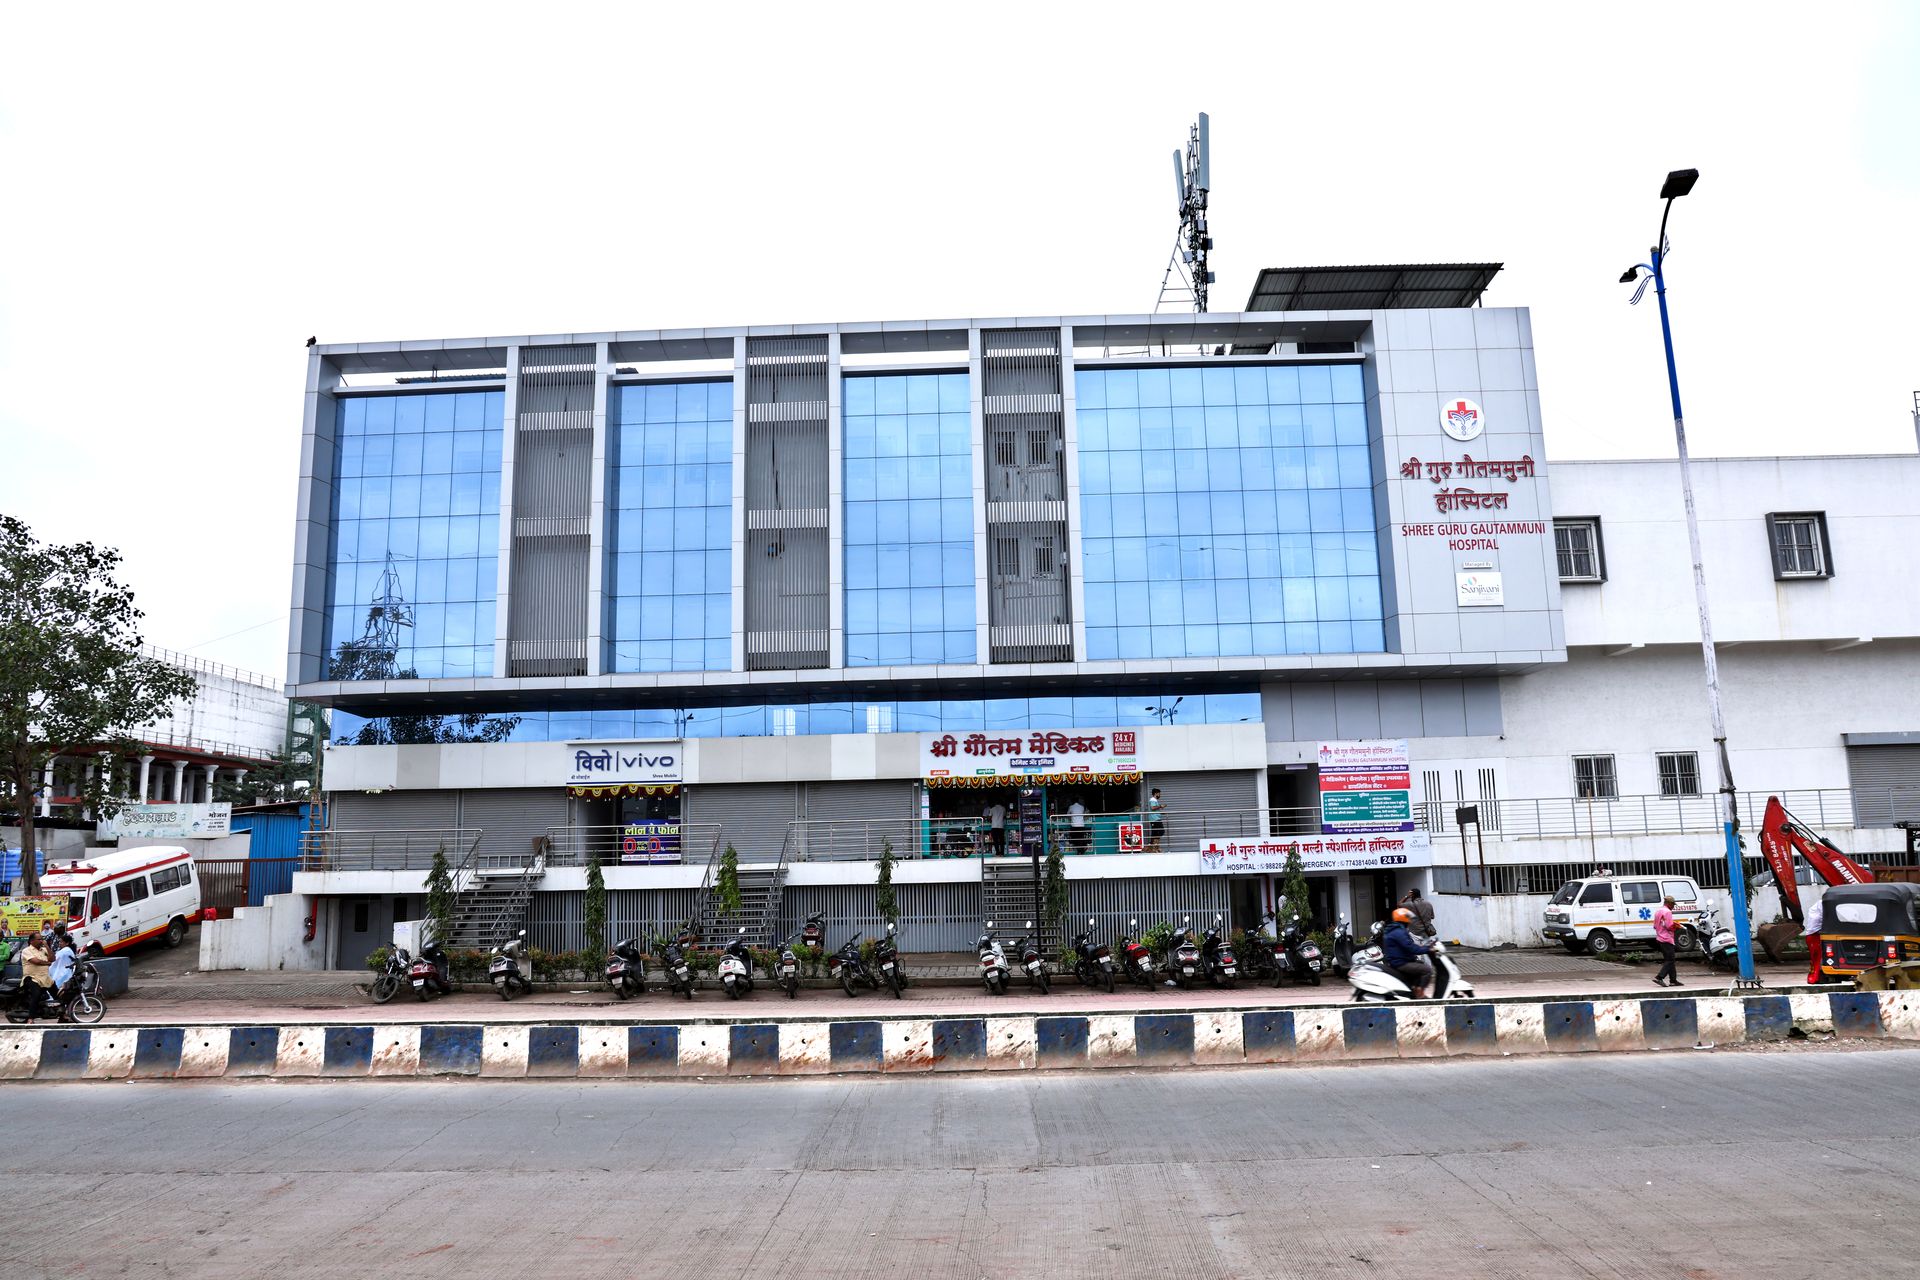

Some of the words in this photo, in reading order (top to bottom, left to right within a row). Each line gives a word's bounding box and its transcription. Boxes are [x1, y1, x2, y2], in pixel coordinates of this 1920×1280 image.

[1400, 457, 1422, 479] श्री
[1426, 462, 1452, 483] गुरु
[1456, 454, 1535, 483] गौतममुनी
[1434, 487, 1509, 514] हॉस्पिटल
[1402, 524, 1434, 536] SHREE
[1437, 523, 1467, 536] GURU
[1471, 522, 1546, 535] GAUTAMMUNI
[1449, 539, 1499, 551] HOSPITAL
[930, 734, 958, 757] श्री
[963, 733, 1023, 757] गौतम
[1028, 732, 1106, 756] मेडिकल
[1114, 734, 1123, 742] 24
[1129, 733, 1133, 741] 7
[575, 749, 612, 772] विवो
[623, 753, 674, 768] vivo
[1227, 843, 1236, 856] श्री
[1239, 845, 1255, 860] गुरु
[1302, 839, 1323, 853] मल्टी
[1326, 838, 1366, 854] स्पेशालिटी
[1369, 836, 1404, 854] हॉस्पिटल
[1382, 856, 1392, 864] 24
